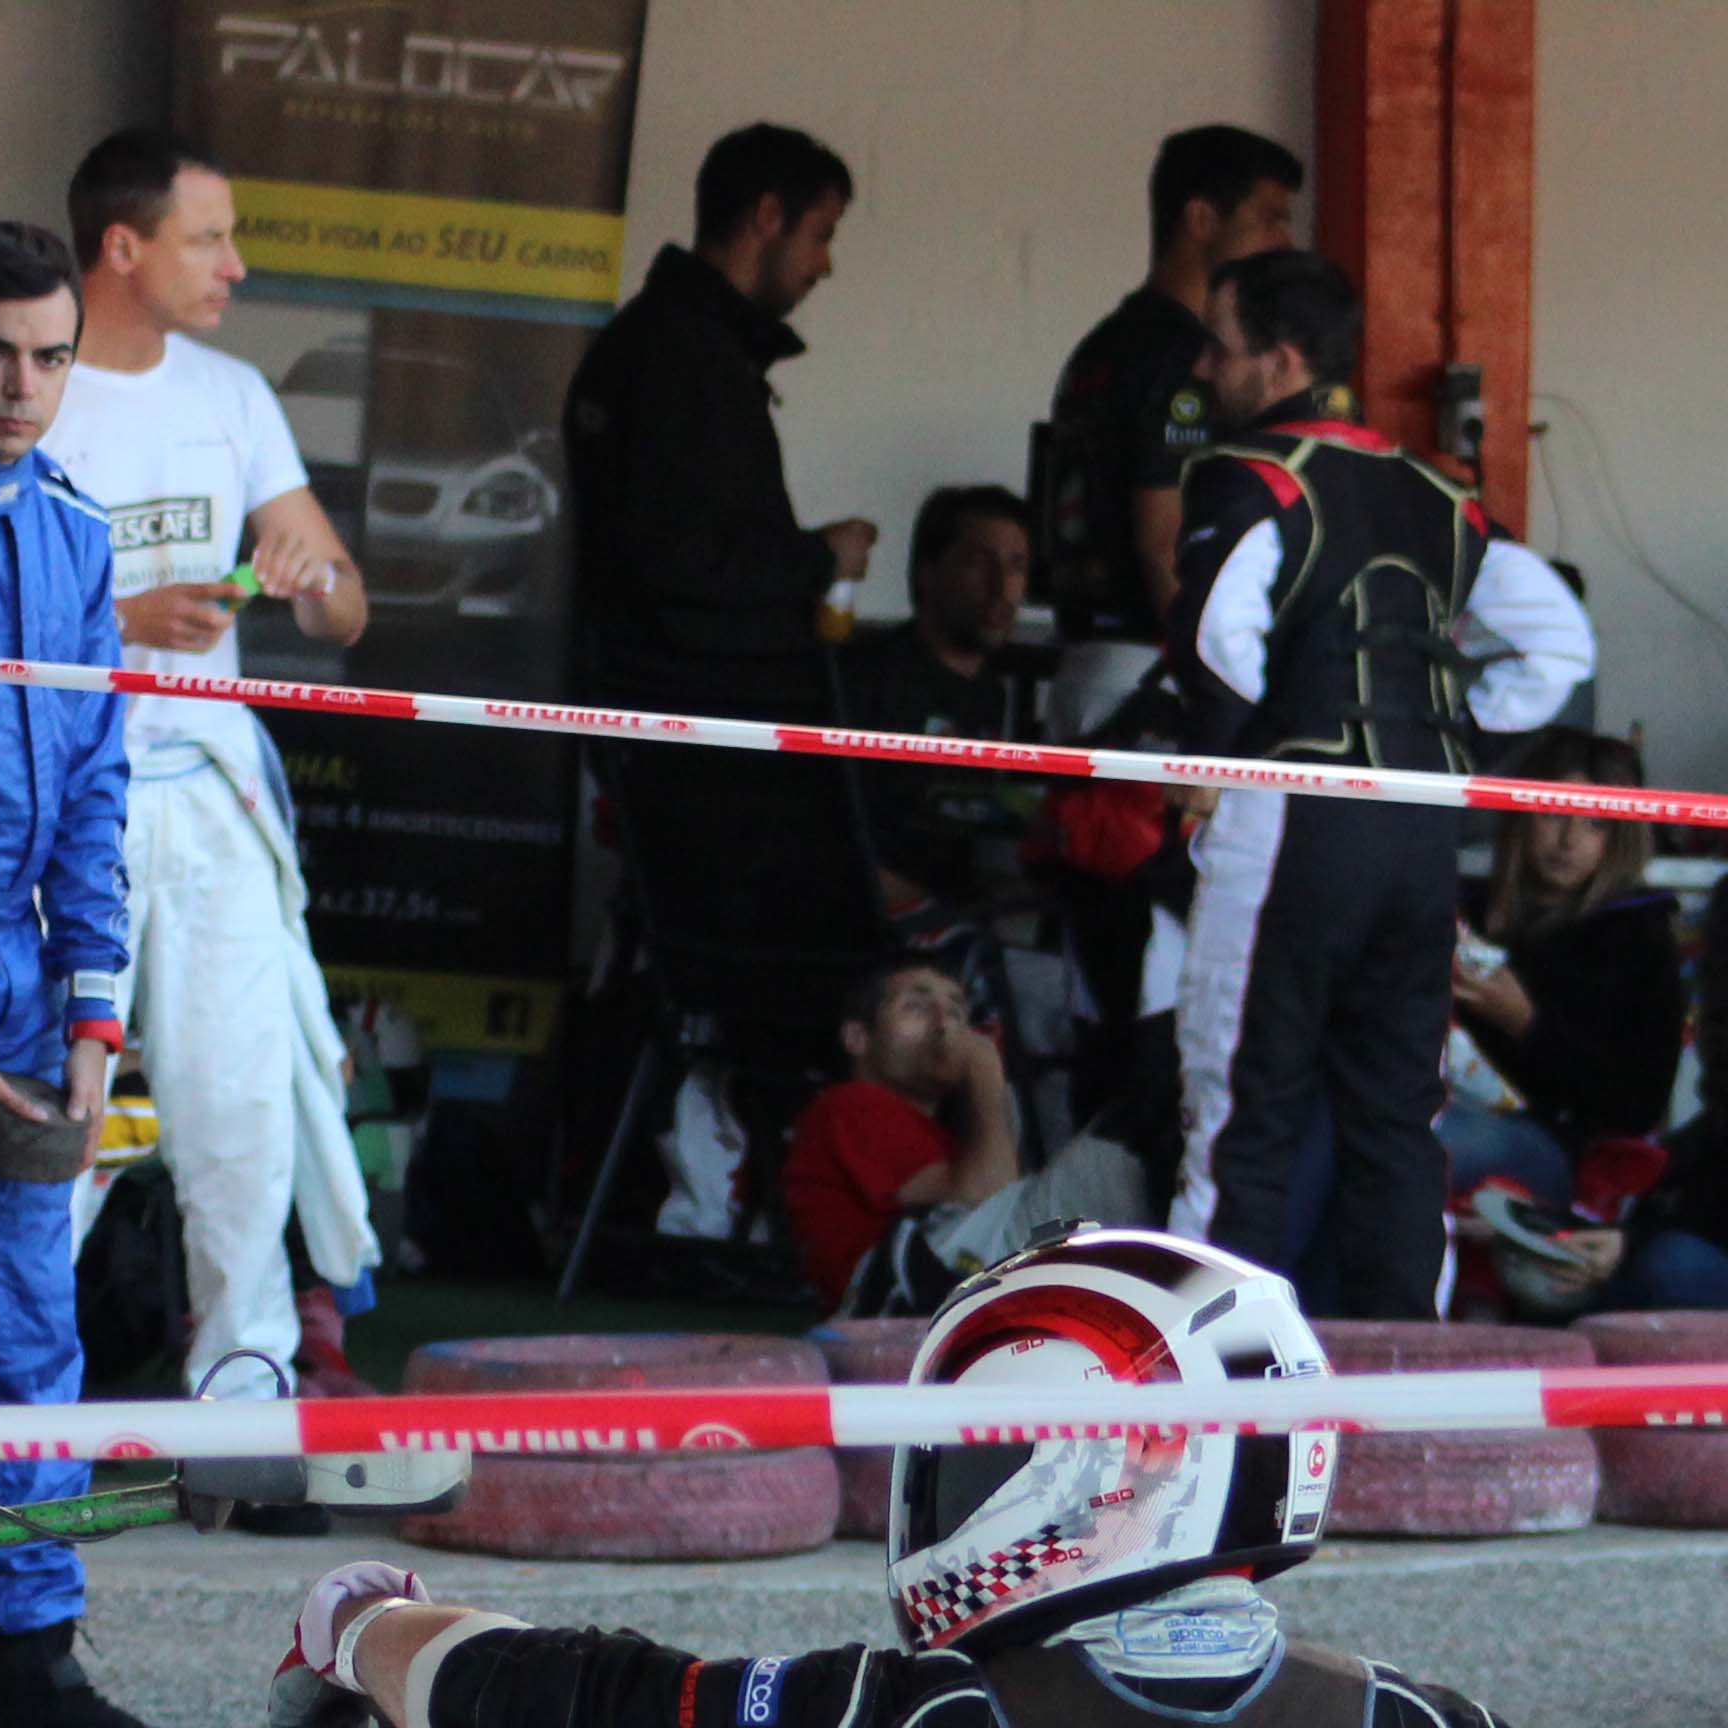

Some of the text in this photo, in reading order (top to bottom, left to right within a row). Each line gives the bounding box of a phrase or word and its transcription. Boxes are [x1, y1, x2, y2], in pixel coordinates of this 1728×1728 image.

[233, 217, 311, 246] AMOS
[319, 222, 381, 250] VIDA
[434, 222, 510, 263] SEU
[110, 498, 205, 549] ESCAFÉ
